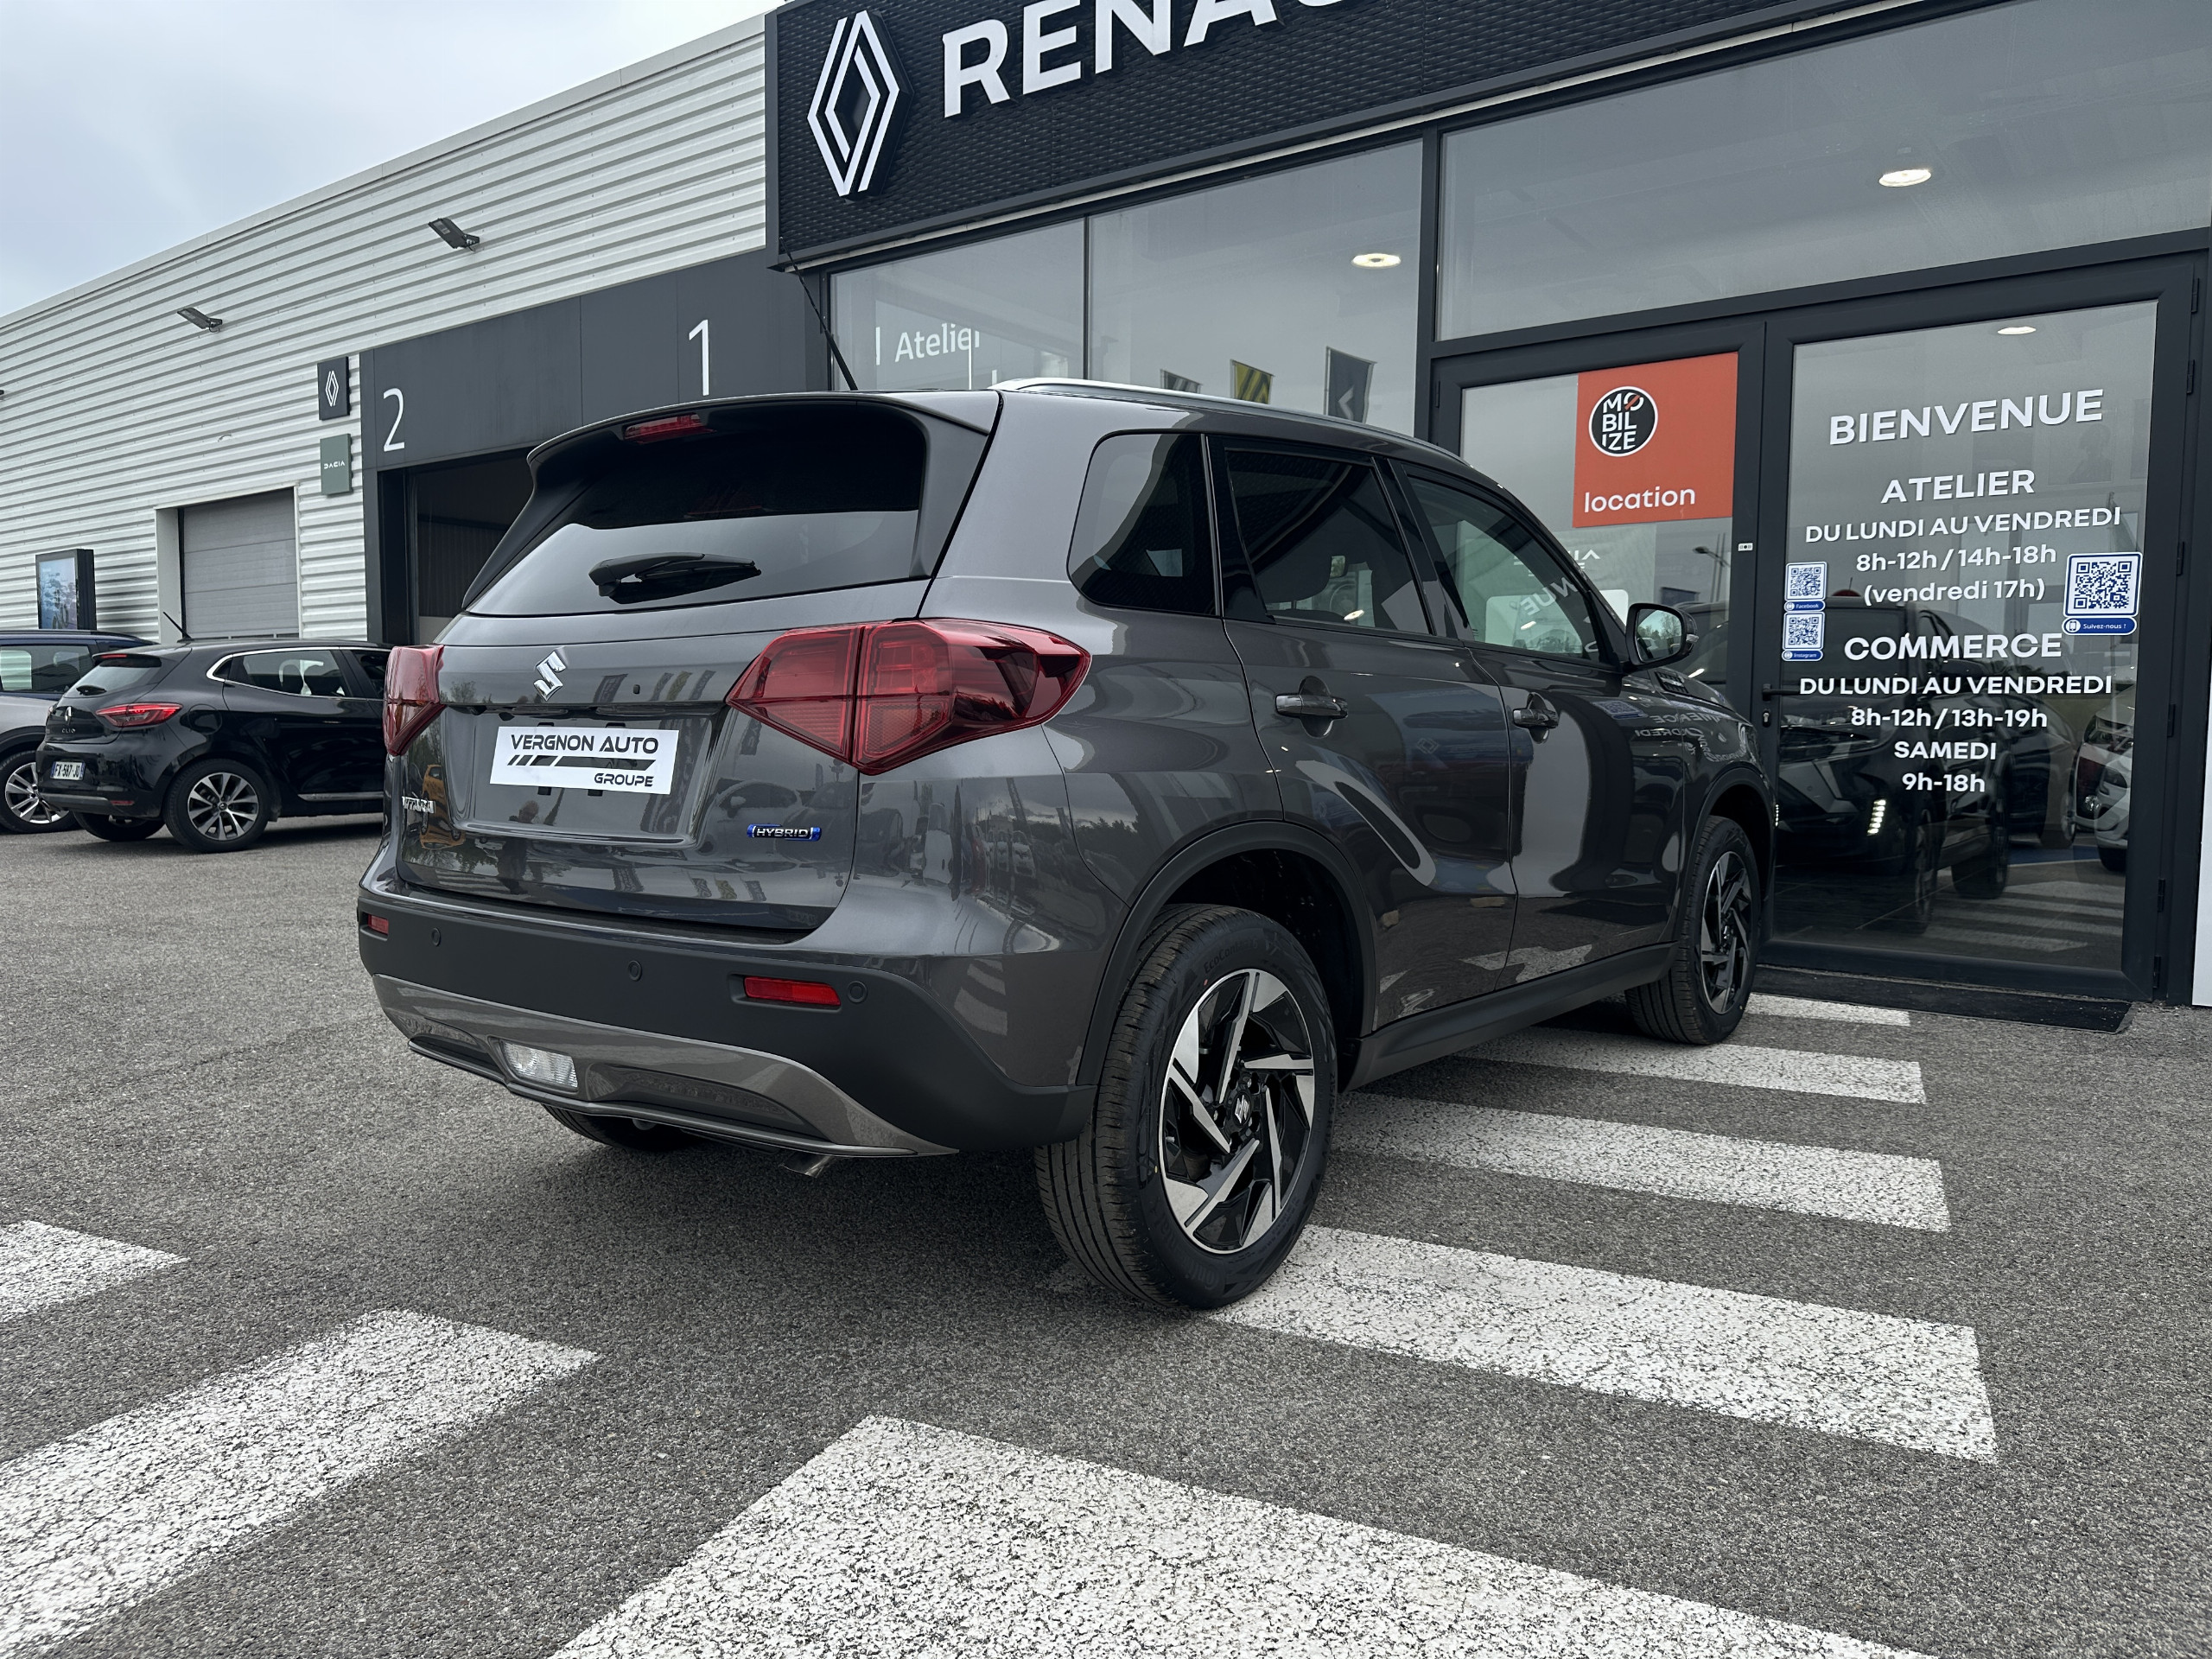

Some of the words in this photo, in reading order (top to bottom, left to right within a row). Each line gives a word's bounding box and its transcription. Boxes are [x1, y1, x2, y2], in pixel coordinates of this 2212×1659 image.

[942, 0, 1344, 118] RENA
[689, 319, 710, 397] 1
[383, 387, 405, 452] 2
[1602, 411, 1637, 433] BIL
[1829, 389, 2104, 445] BIENVENUE
[1601, 431, 1637, 451] IZE
[323, 460, 346, 469] DACIA
[1880, 469, 2036, 504] ATELIER
[1584, 486, 1696, 513] location
[1805, 524, 1841, 543] DU
[1846, 519, 1924, 541] LUNDI
[1929, 516, 1969, 536] AU
[1974, 507, 2121, 533] VENDREDI
[1856, 550, 1937, 572] 8h-12h
[1958, 543, 2057, 569] 14h-18h
[1864, 580, 1988, 607] (vendredi
[1993, 578, 2046, 601] 17h)
[1843, 632, 2063, 661] COMMERCE
[1800, 677, 1835, 695] DU
[1840, 677, 1917, 695] LUNDI
[1923, 677, 1961, 695] AU
[1966, 676, 2112, 695] VENDREDI
[1850, 709, 1931, 727] 8h-12h
[1951, 708, 2048, 728] 13h-19h
[511, 734, 594, 751] VERGNON
[599, 735, 659, 753] AUTO
[1894, 741, 1996, 760] SAMEDI
[594, 773, 654, 787] GROUPE
[1902, 773, 1986, 792] 9h-18h
[756, 828, 809, 837] HYBRID
